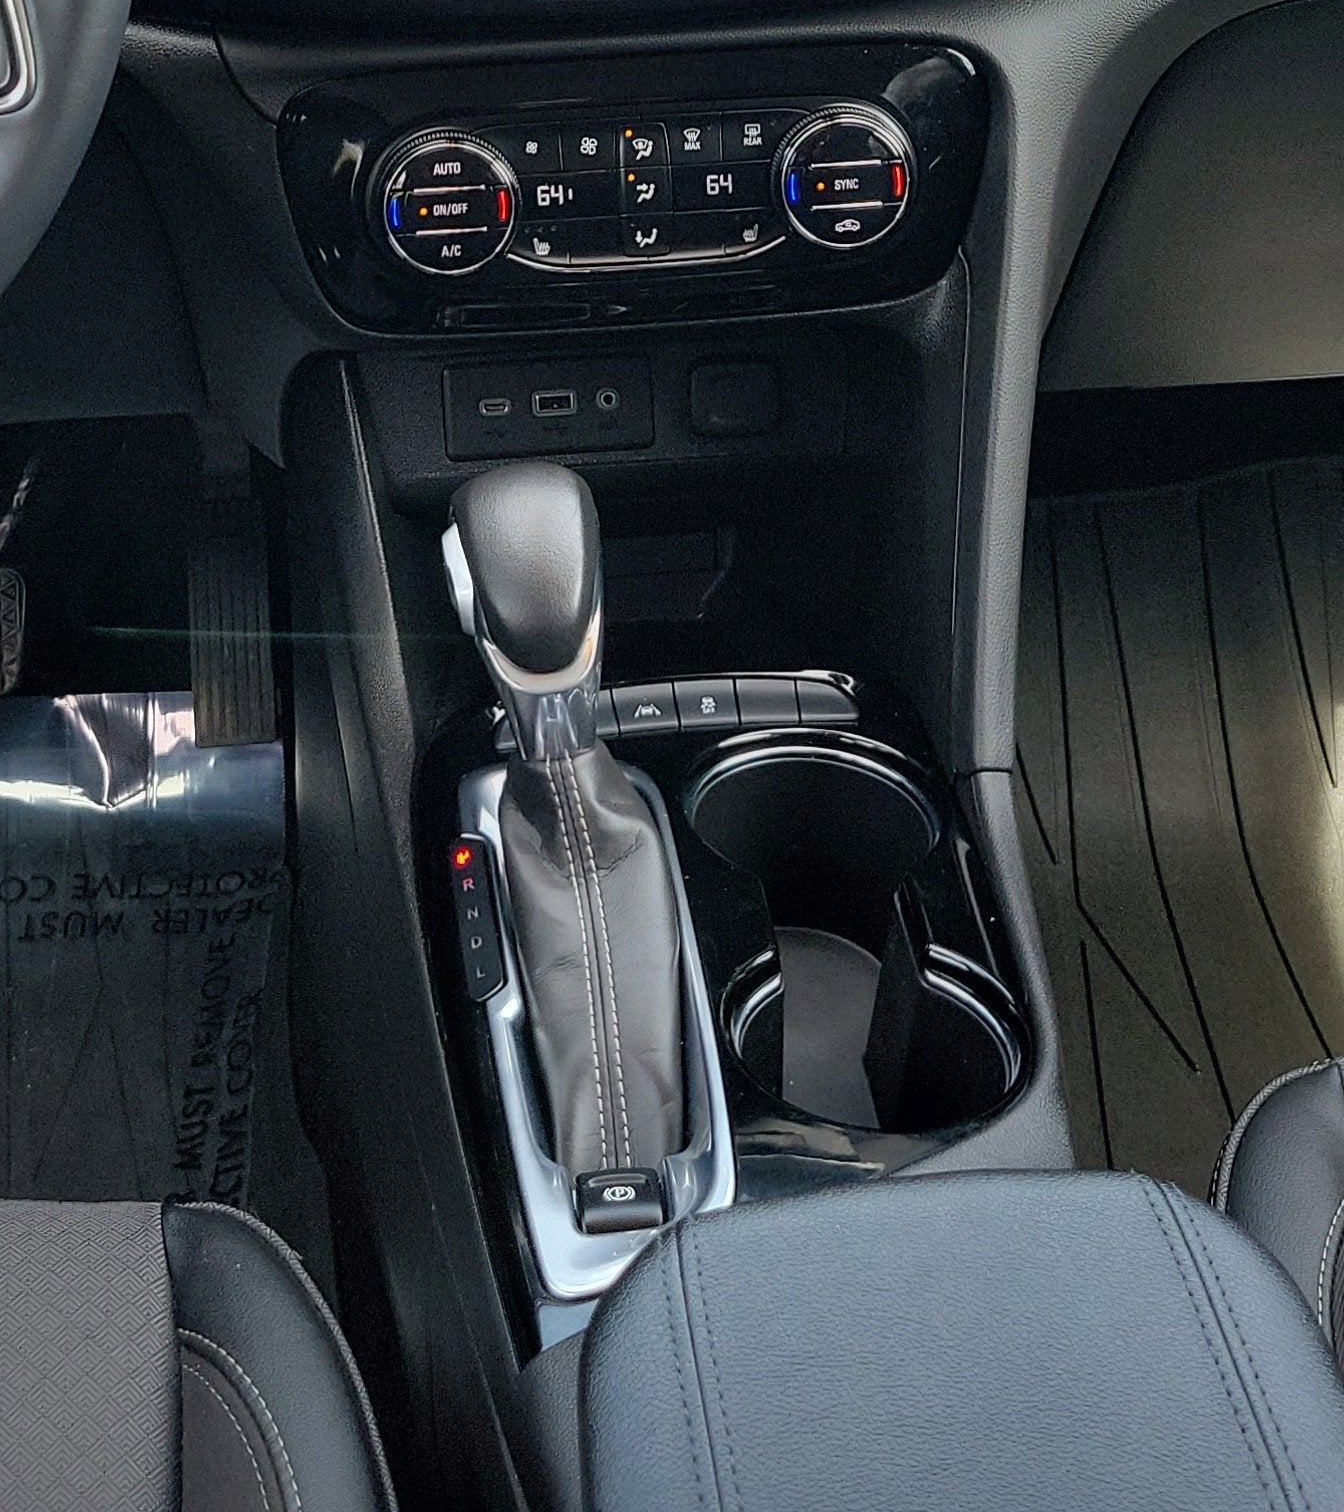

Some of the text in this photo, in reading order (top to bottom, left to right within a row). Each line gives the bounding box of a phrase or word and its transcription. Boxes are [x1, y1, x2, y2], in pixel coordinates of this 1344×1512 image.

[683, 141, 701, 151] MAX
[743, 136, 762, 147] REAR
[432, 161, 462, 176] AUTO
[706, 173, 733, 195] 64
[833, 178, 860, 191] SYNC
[536, 184, 564, 207] 64
[432, 202, 469, 217] ON/OFF
[441, 243, 462, 258] A/C
[462, 877, 475, 892] R
[467, 906, 480, 920] N
[17, 908, 127, 944] MUST
[471, 936, 483, 950] D
[476, 966, 486, 979] L
